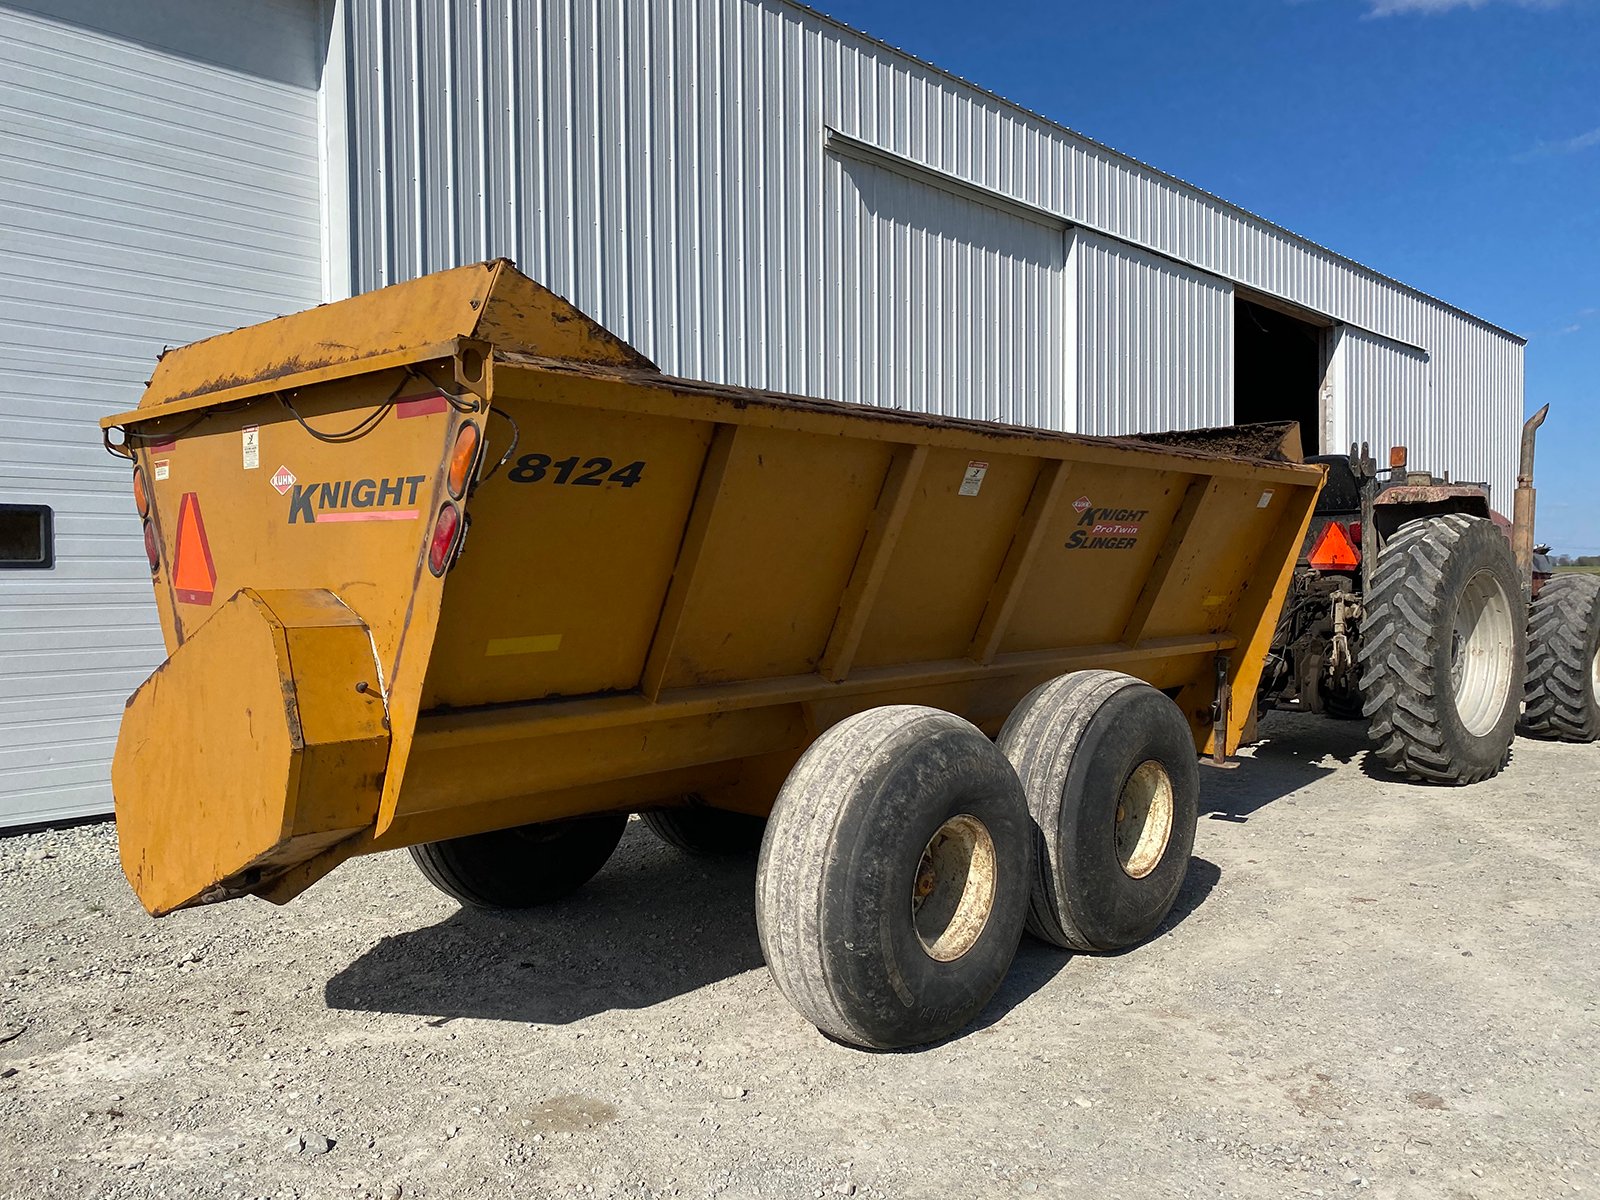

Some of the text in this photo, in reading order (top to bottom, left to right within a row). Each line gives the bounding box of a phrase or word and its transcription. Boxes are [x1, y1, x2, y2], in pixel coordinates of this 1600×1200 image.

[507, 453, 646, 488] 8124
[273, 475, 293, 487] KUHN
[288, 475, 426, 524] KNIGHT
[1077, 507, 1149, 526] KNIGHT
[1092, 524, 1138, 534] ProTwin
[1064, 529, 1137, 549] SLINGER
